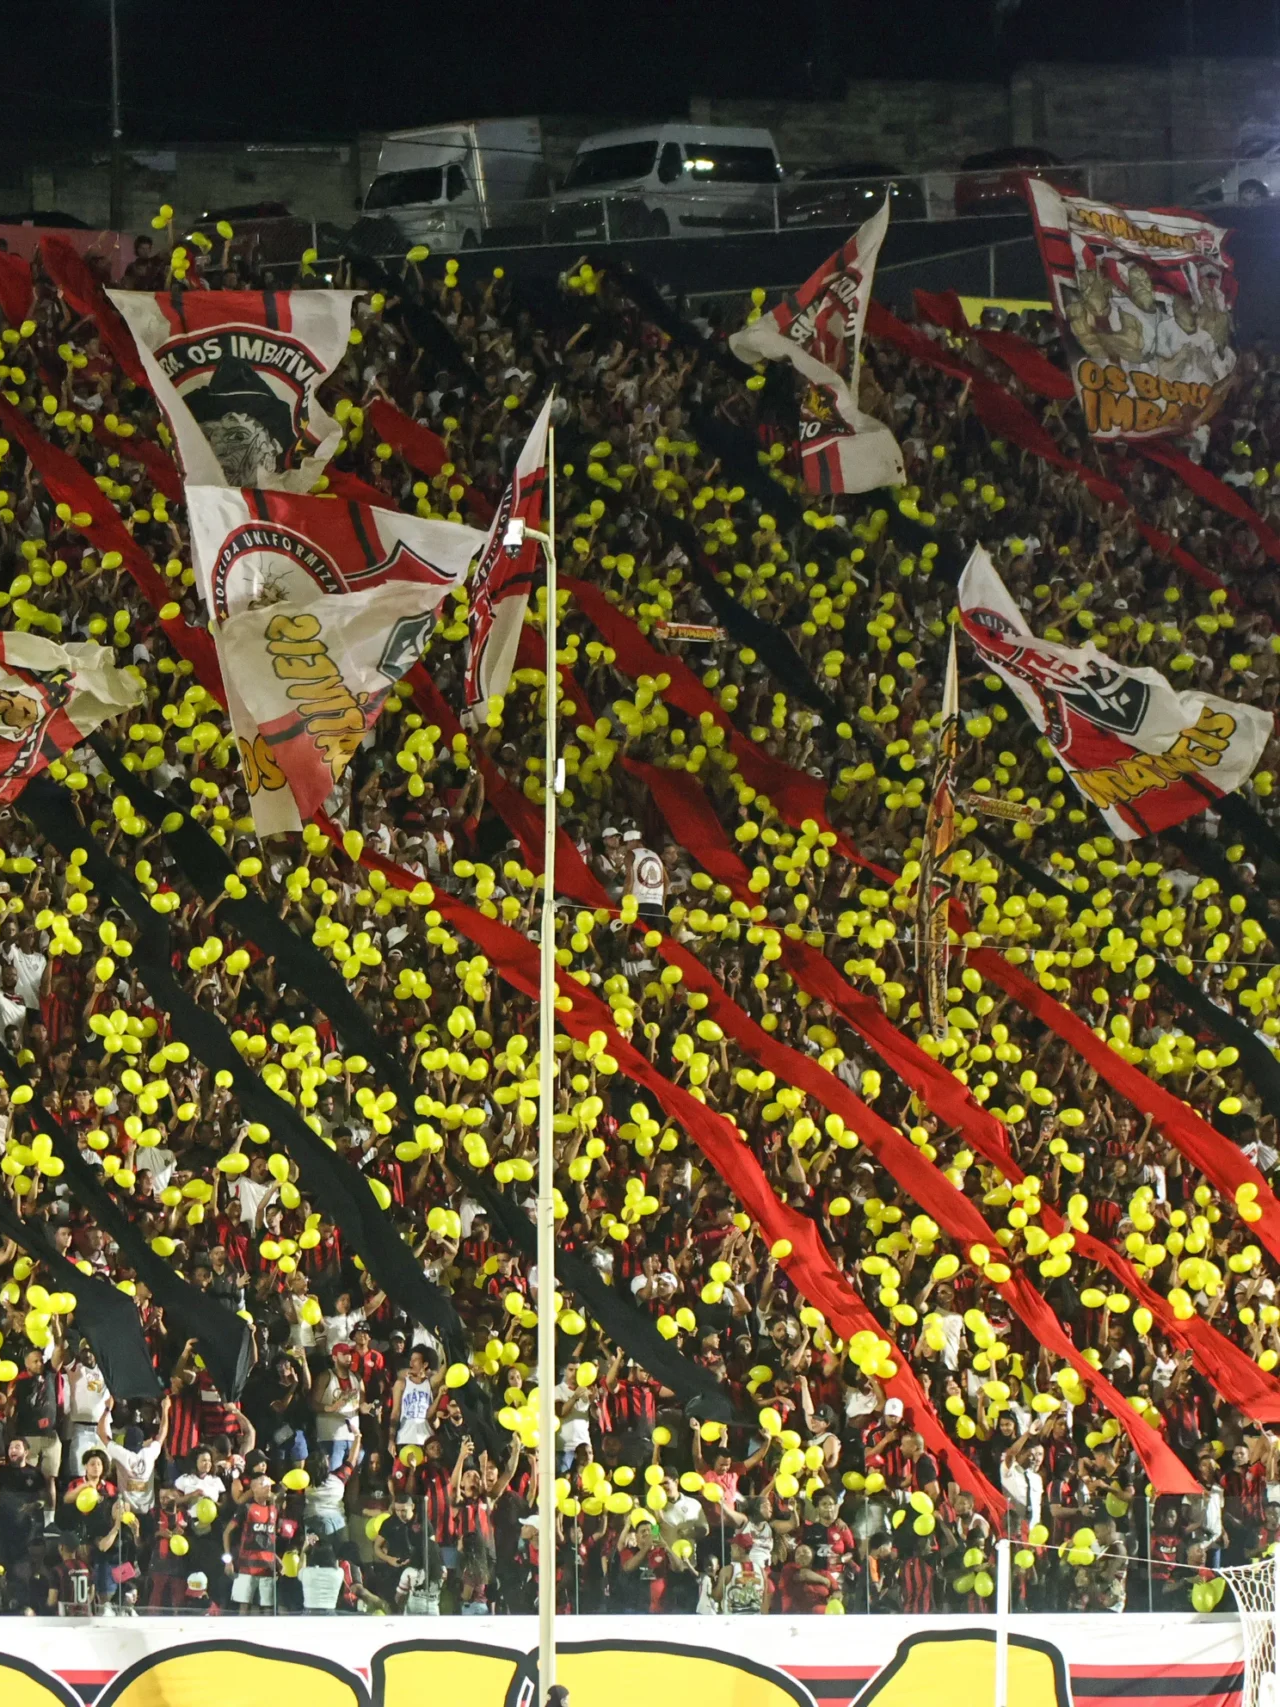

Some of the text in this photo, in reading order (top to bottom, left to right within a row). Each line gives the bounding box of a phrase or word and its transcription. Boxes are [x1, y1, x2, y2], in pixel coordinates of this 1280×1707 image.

[188, 337, 222, 364] OS
[1078, 360, 1129, 394] OS
[214, 543, 241, 605] TORCIDA
[70, 1575, 88, 1604] 10
